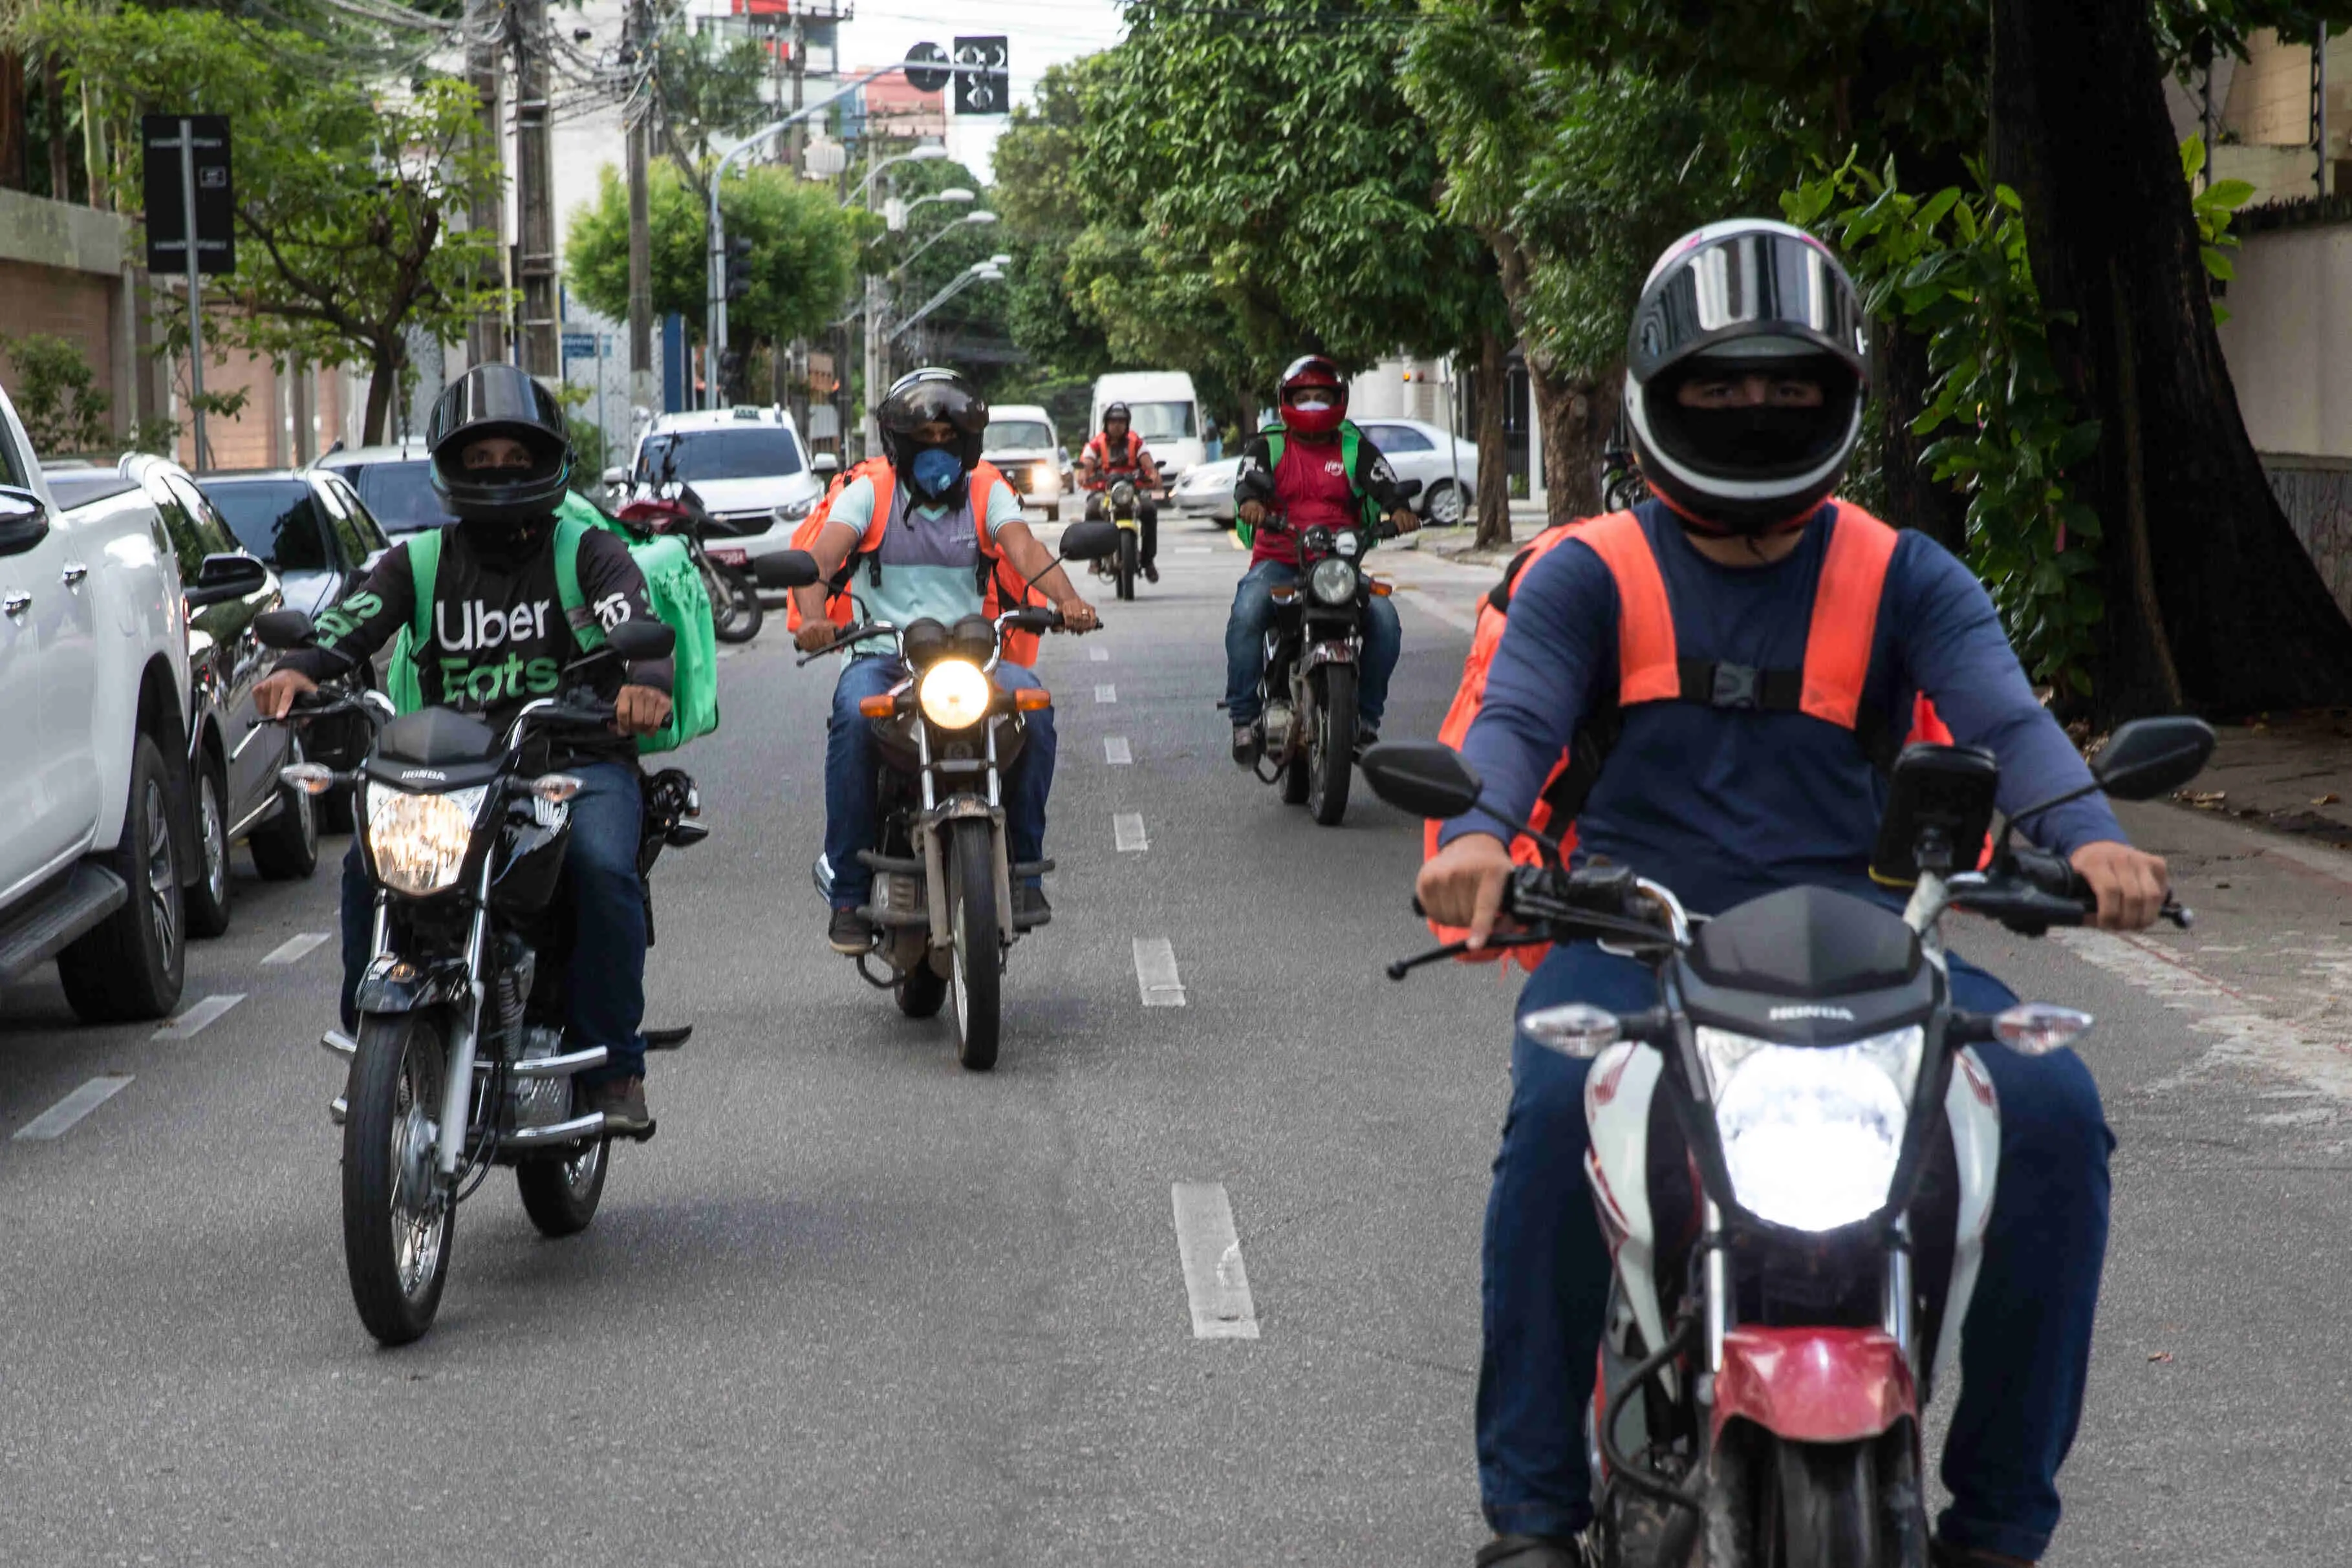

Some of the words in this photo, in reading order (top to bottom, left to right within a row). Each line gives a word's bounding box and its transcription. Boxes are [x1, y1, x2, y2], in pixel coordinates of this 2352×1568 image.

[435, 599, 550, 651] Uber
[439, 651, 559, 703] Eats
[401, 769, 446, 781] HONDA
[1769, 1005, 1854, 1021] HONDA
